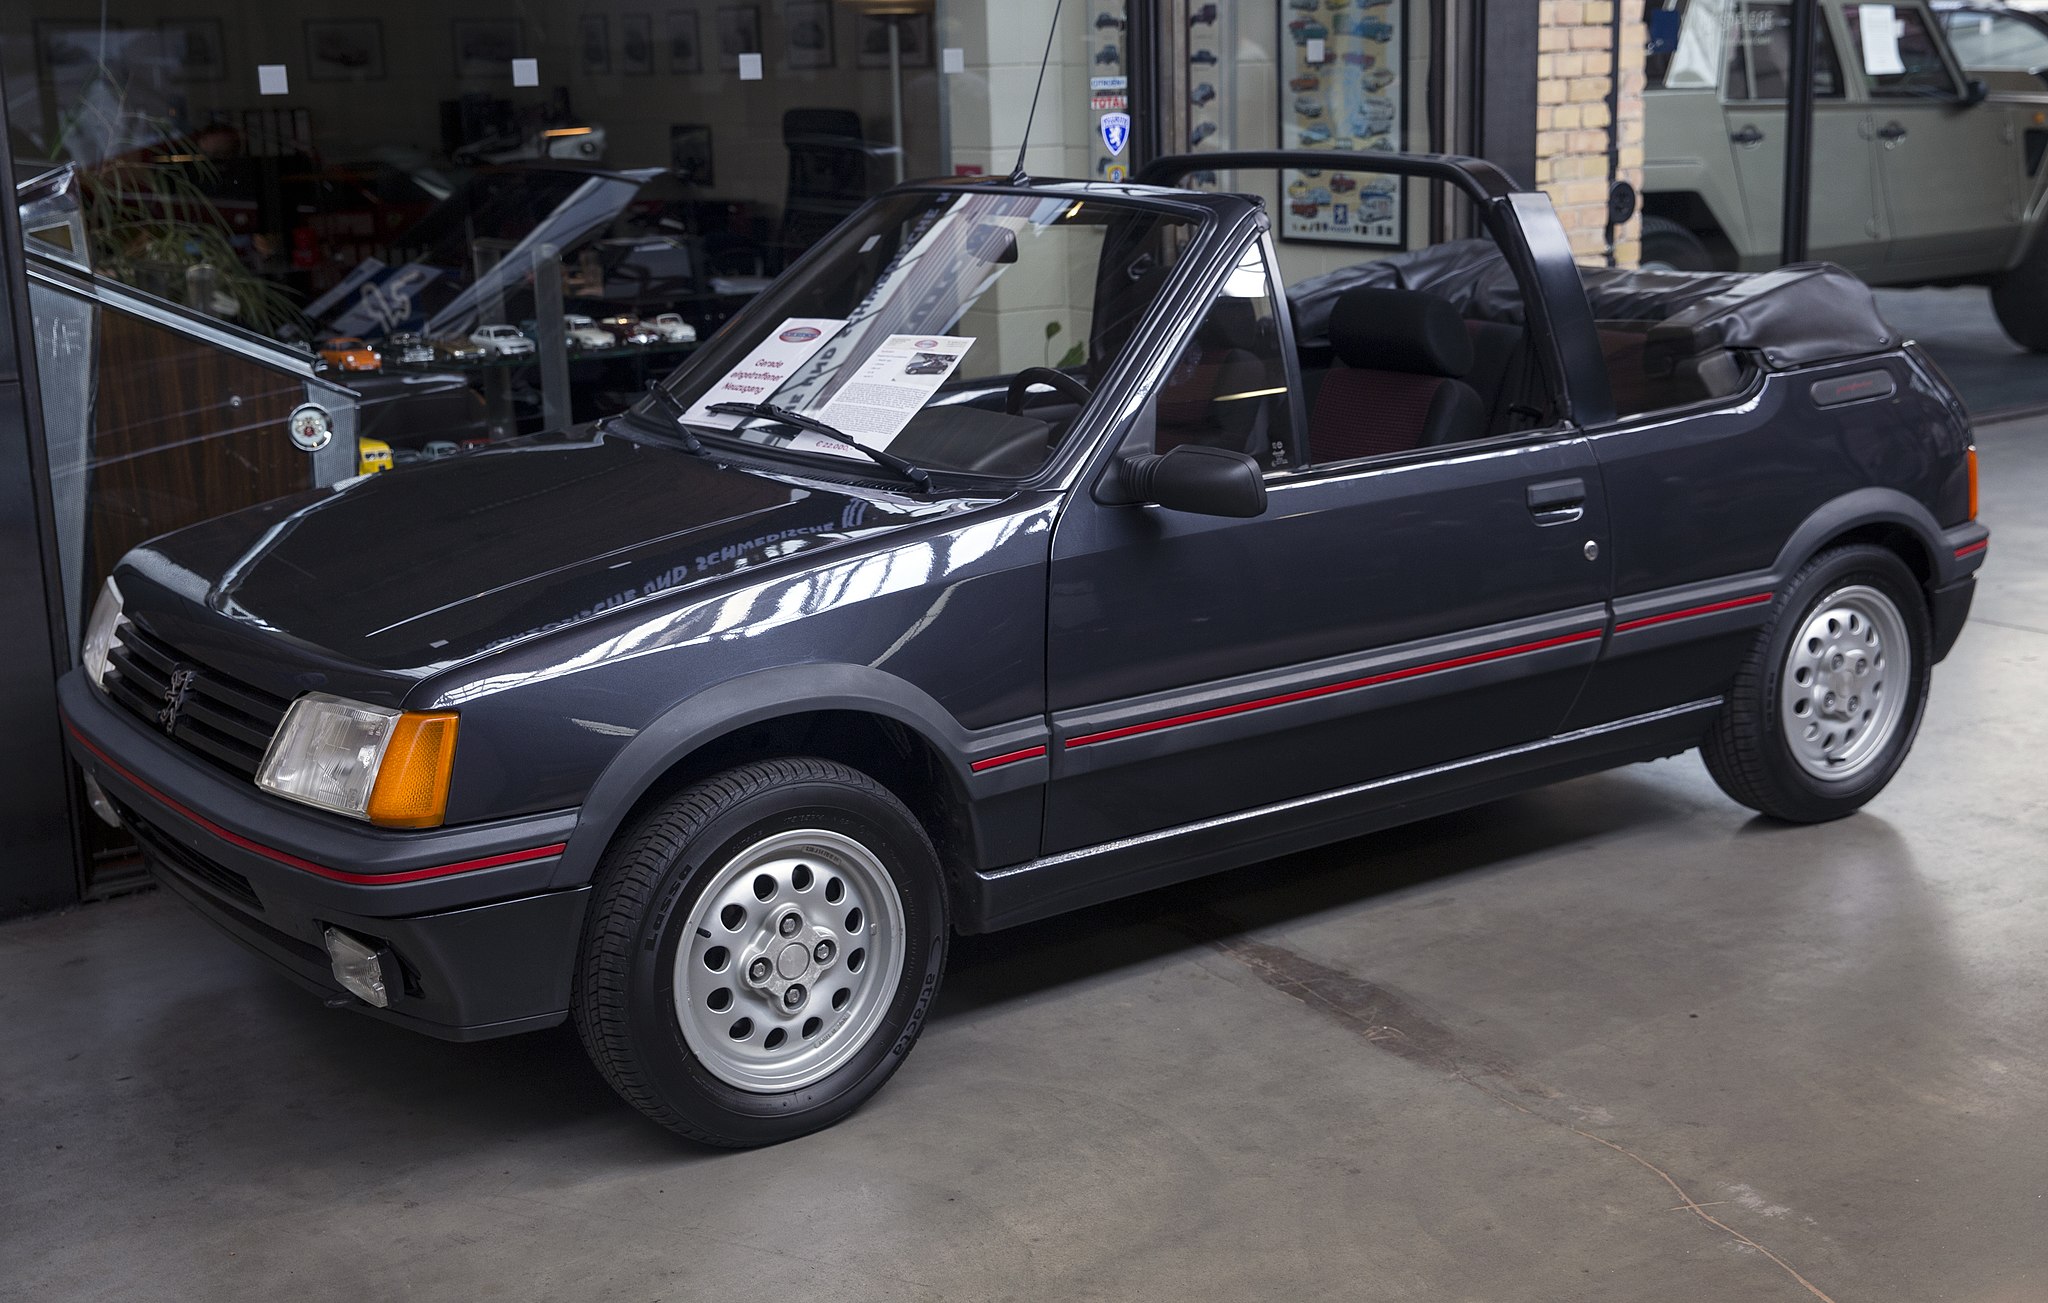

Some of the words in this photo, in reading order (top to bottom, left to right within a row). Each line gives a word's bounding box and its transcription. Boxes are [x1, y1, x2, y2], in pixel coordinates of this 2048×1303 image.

[1092, 97, 1127, 109] TOTAL
[755, 358, 784, 368] Gerade
[730, 371, 783, 381] eingetroffener
[722, 382, 764, 395] Neuzugang
[644, 864, 693, 951] Lassa
[893, 973, 935, 1055] atracta
